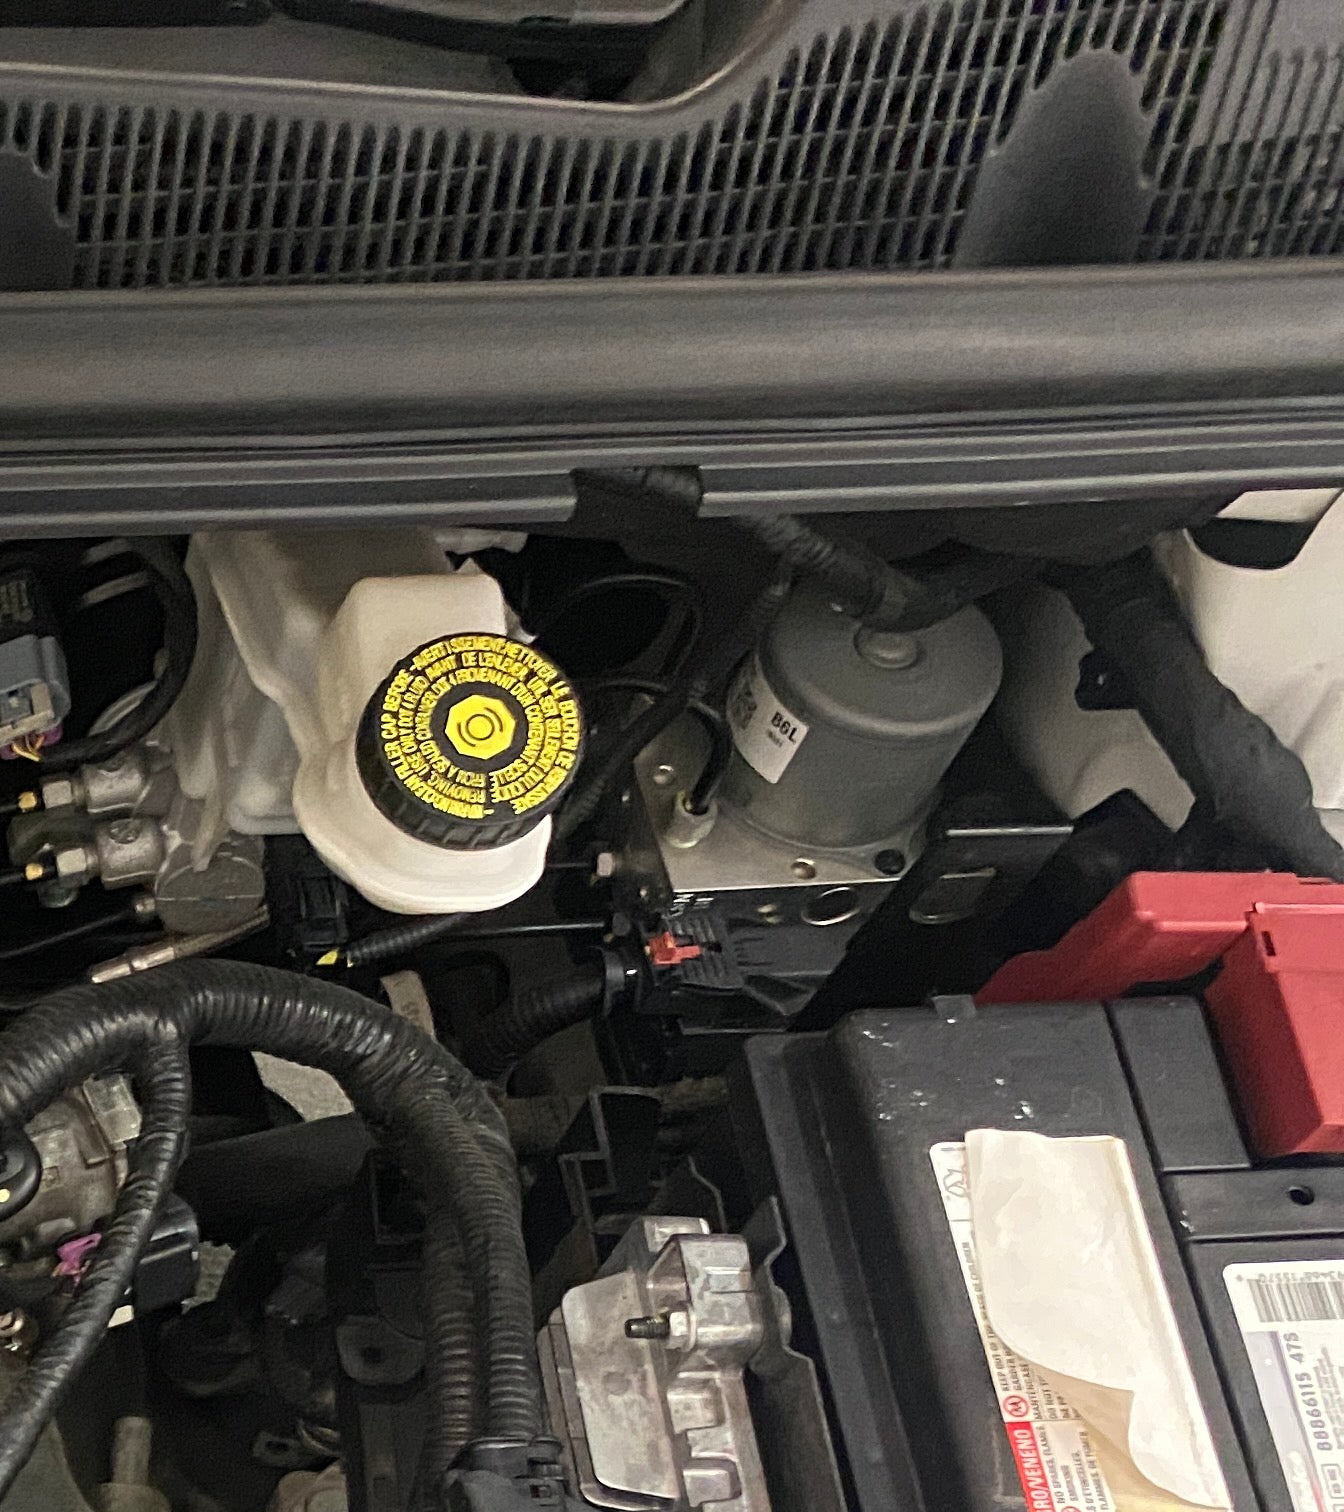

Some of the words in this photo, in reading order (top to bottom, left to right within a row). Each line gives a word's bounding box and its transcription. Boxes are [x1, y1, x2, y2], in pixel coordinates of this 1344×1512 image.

[382, 668, 415, 711] BEFORE
[380, 712, 398, 739] CAP
[404, 751, 431, 778] USE
[418, 739, 452, 775] SEALED
[443, 763, 459, 780] A
[1053, 1491, 1066, 1503] NO
